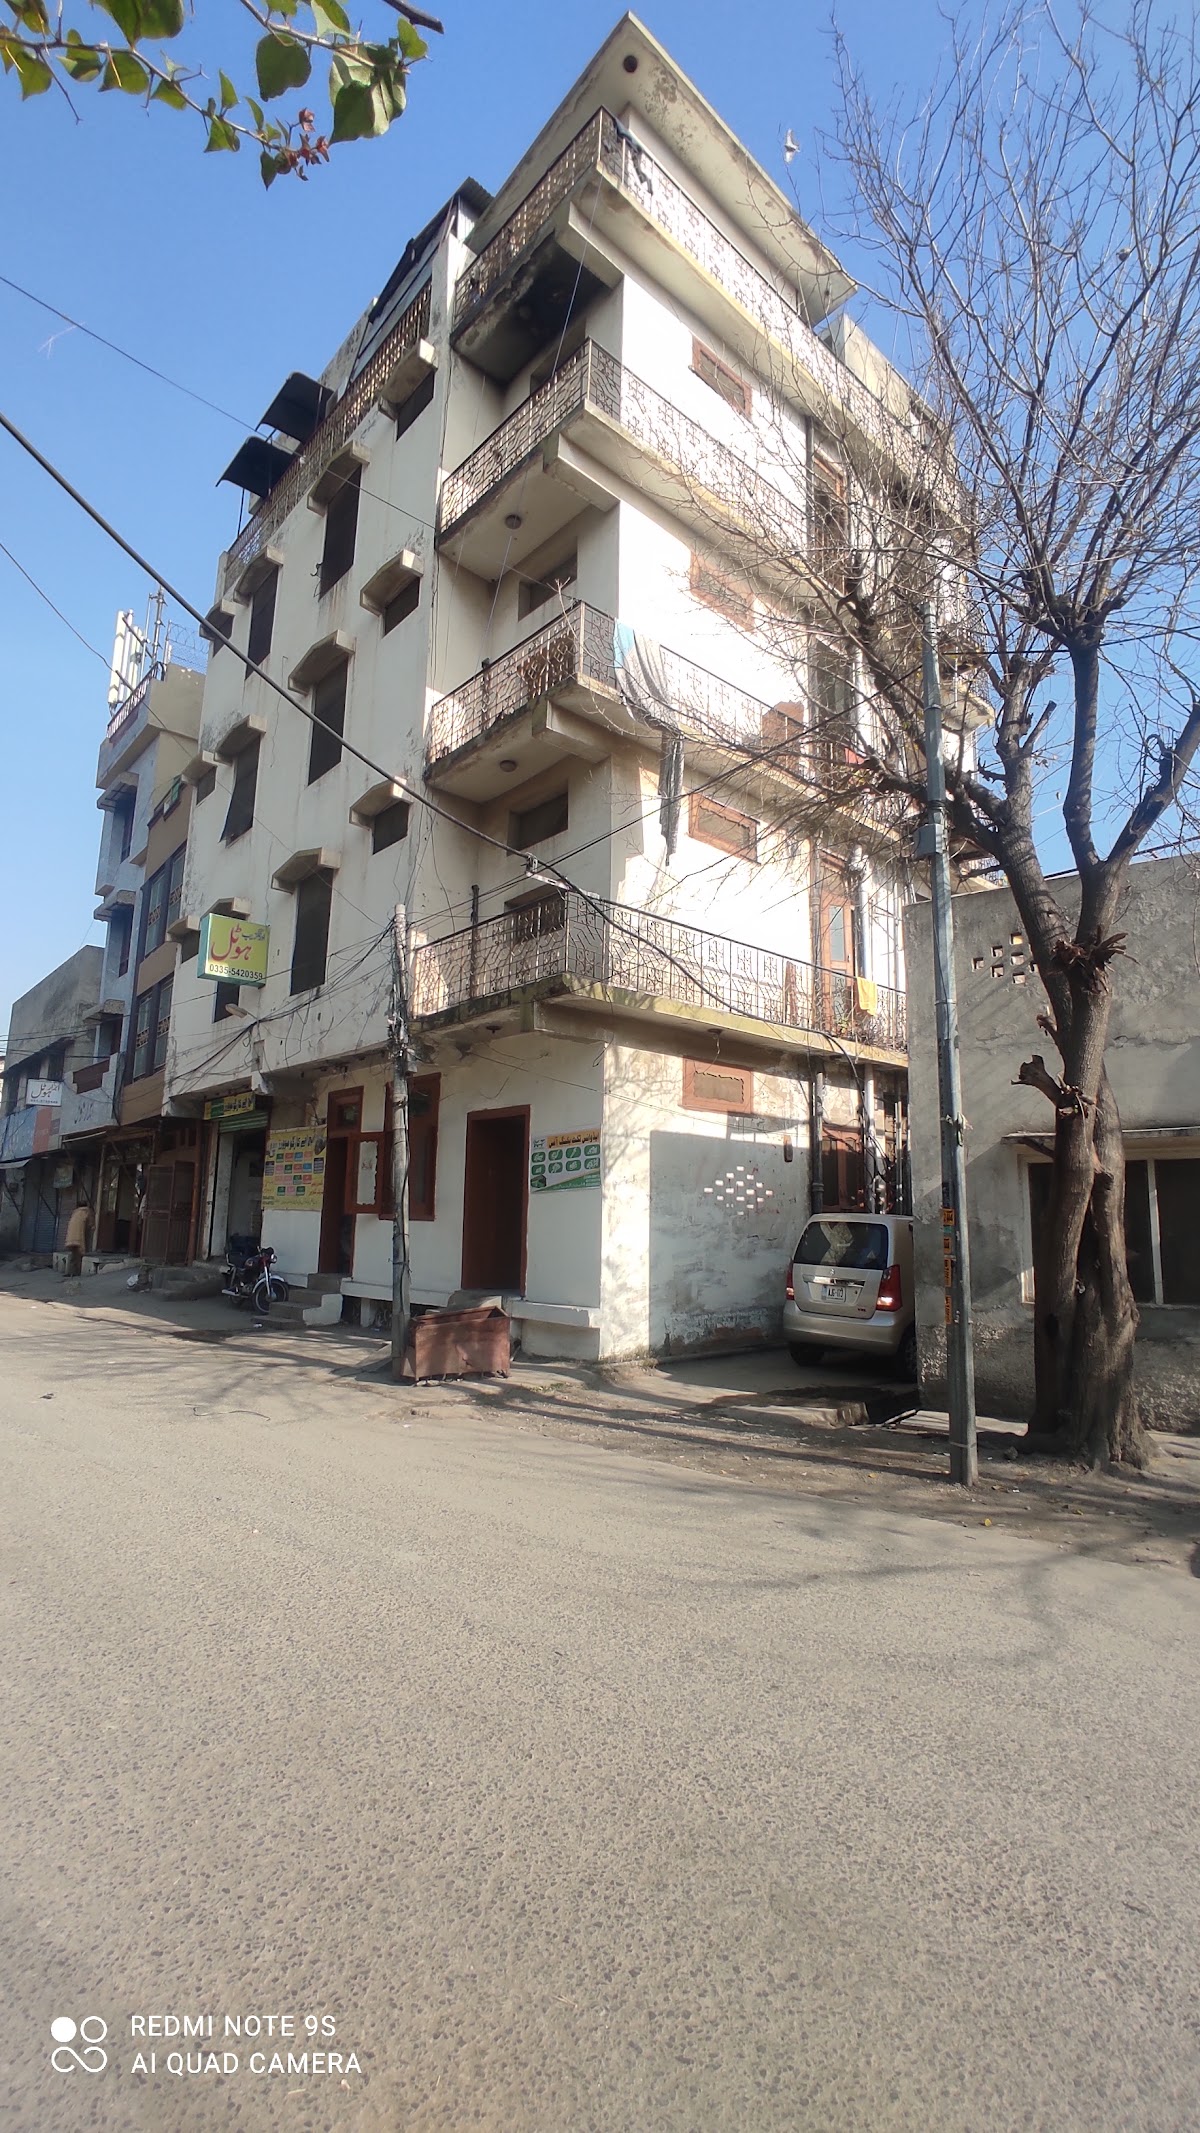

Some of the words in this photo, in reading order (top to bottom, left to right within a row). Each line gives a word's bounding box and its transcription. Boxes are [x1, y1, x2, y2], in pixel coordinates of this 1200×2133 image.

[210, 922, 252, 962] ہوٹل
[209, 963, 264, 981] 0335-5420359
[30, 1083, 52, 1099] ہوٹل
